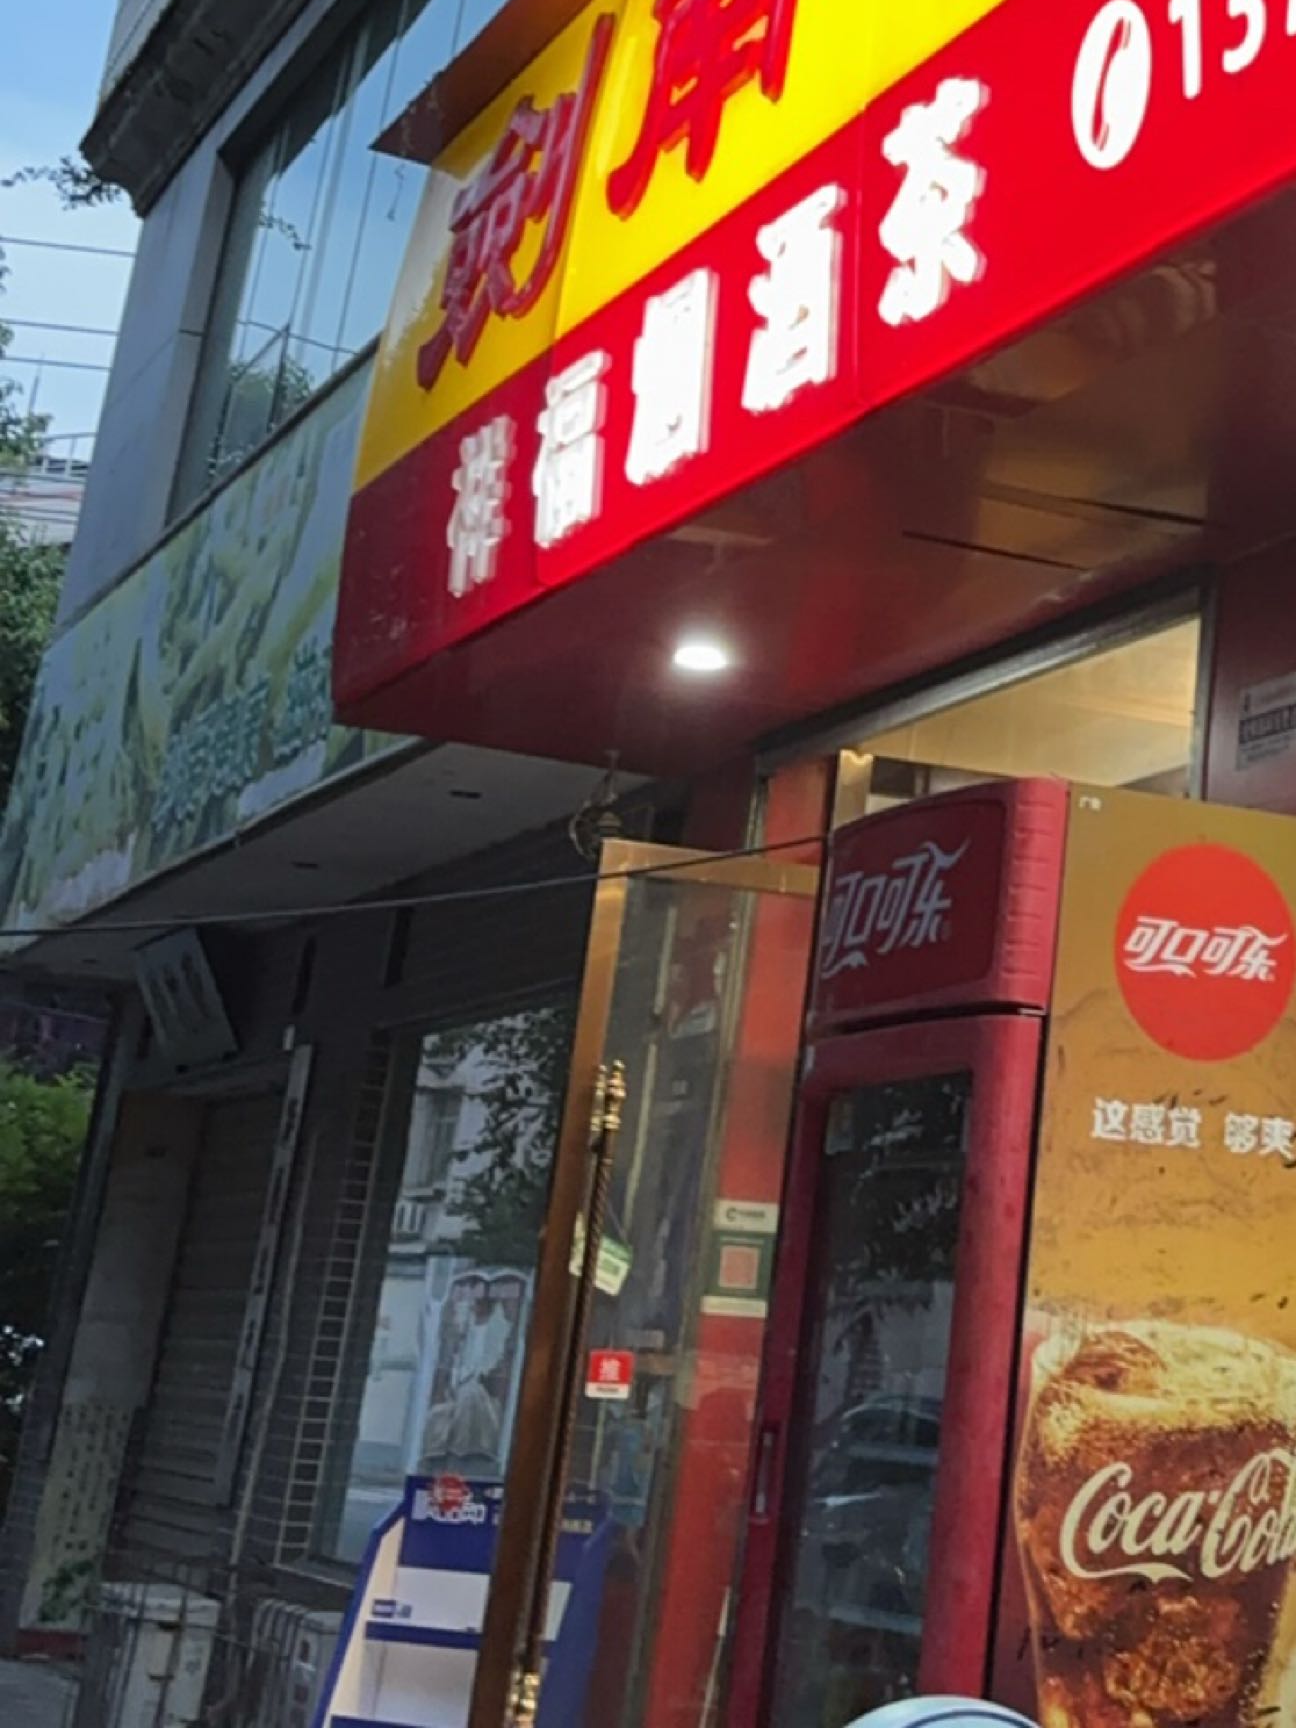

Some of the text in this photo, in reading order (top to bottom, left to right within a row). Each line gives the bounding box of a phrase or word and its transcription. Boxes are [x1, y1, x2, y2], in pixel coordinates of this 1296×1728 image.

[1123, 915, 1288, 981] 可口可乐
[1091, 1096, 1202, 1148] 这感觉
